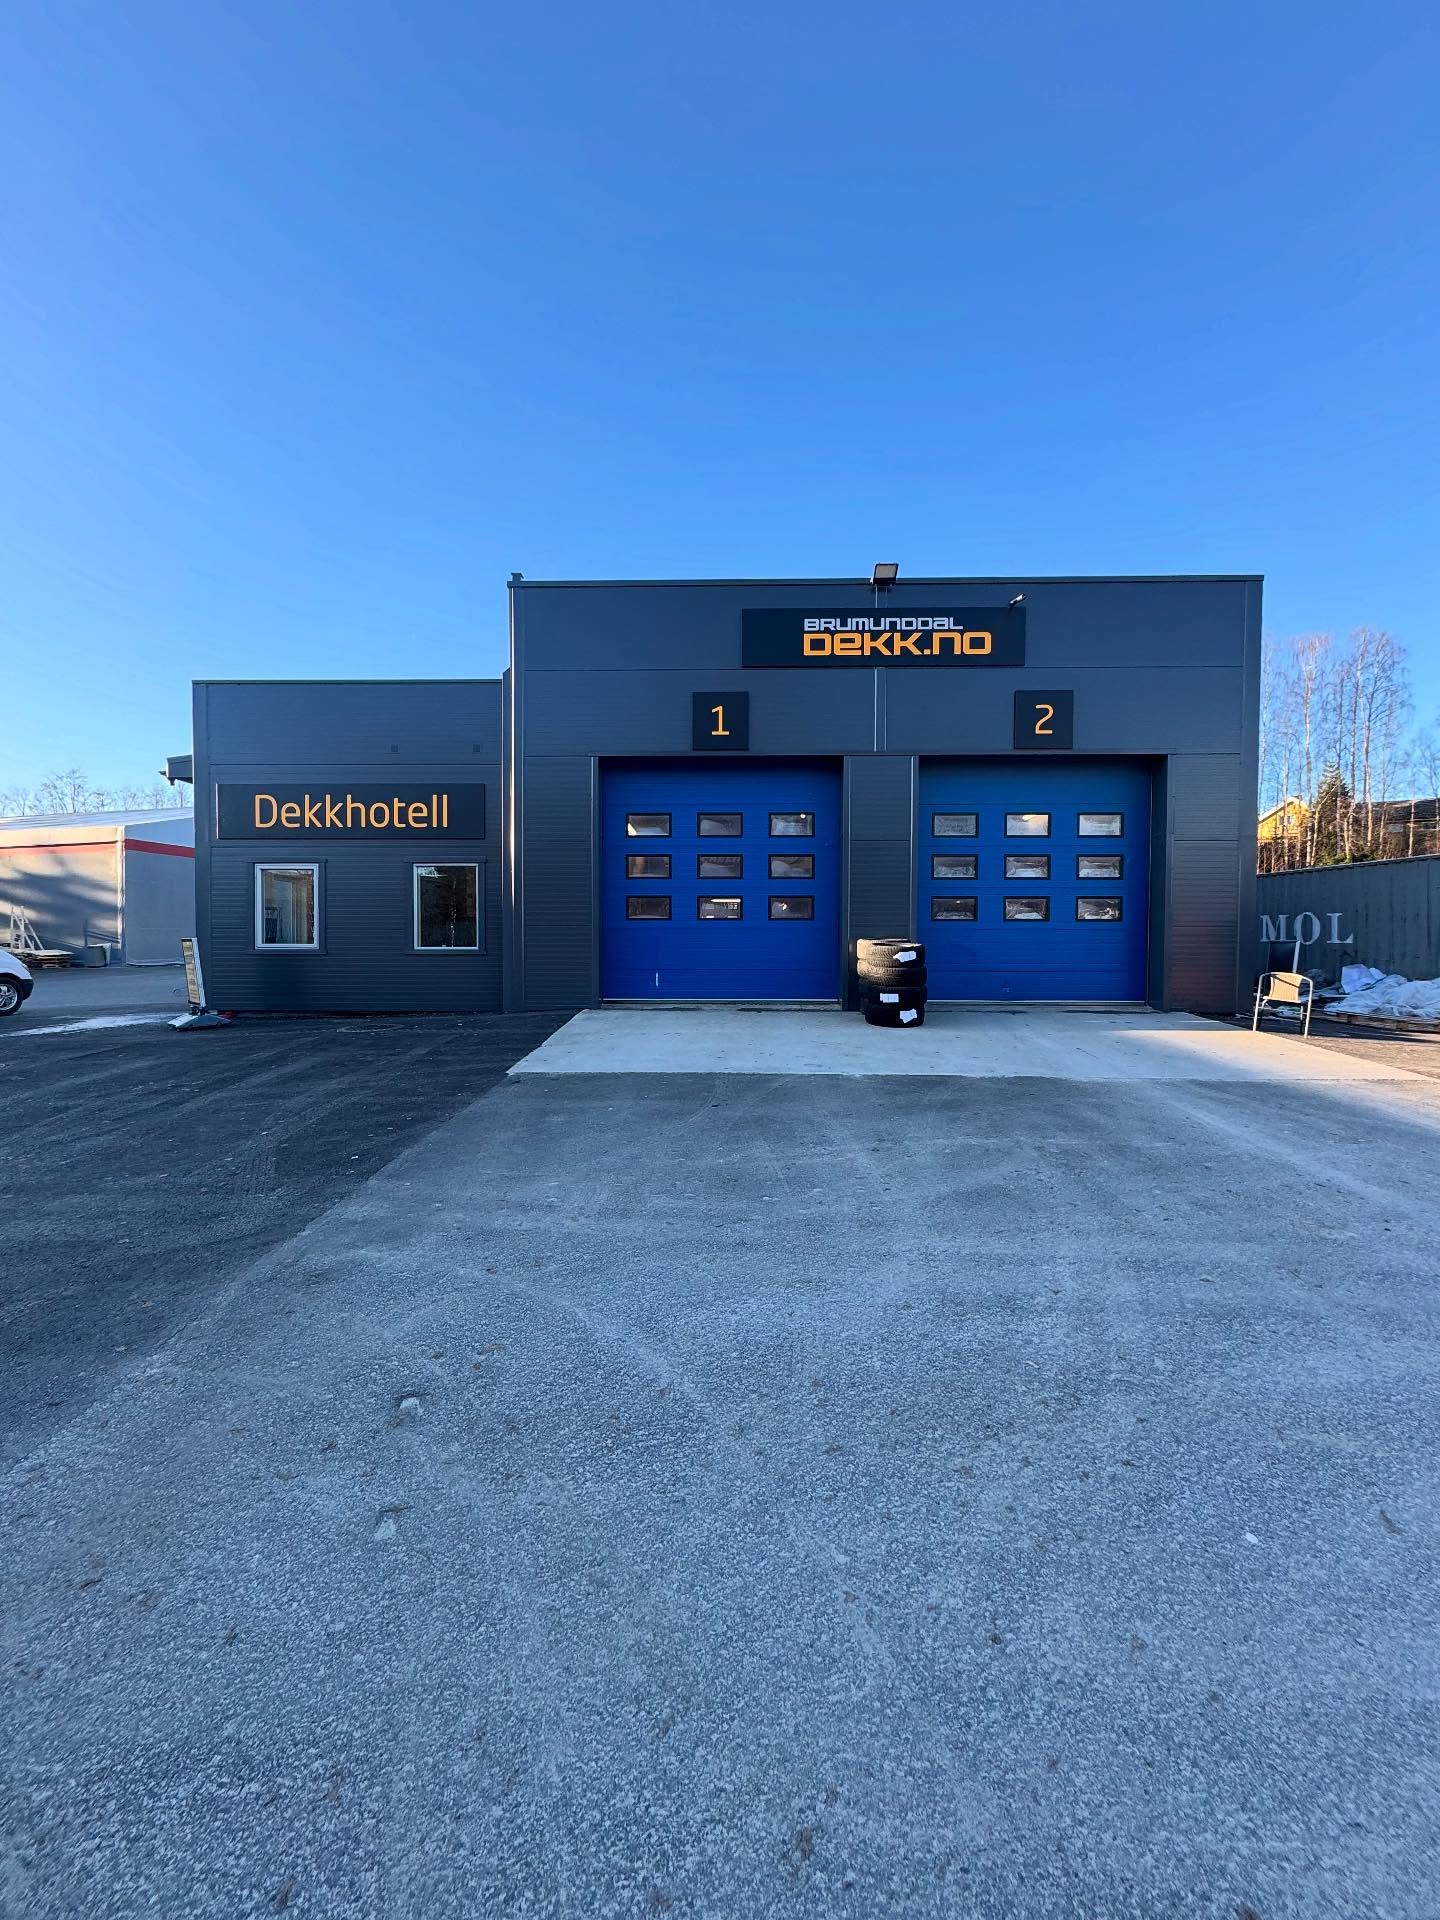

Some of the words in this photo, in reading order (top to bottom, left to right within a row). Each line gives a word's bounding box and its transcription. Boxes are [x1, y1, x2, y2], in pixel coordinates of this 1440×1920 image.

[804, 617, 963, 631] BRUMUNDDAL
[803, 631, 992, 656] DEKK.NO
[711, 705, 730, 736] 1
[1034, 704, 1054, 735] 2
[255, 794, 448, 828] Dekkhotell
[1260, 912, 1354, 945] MOL
